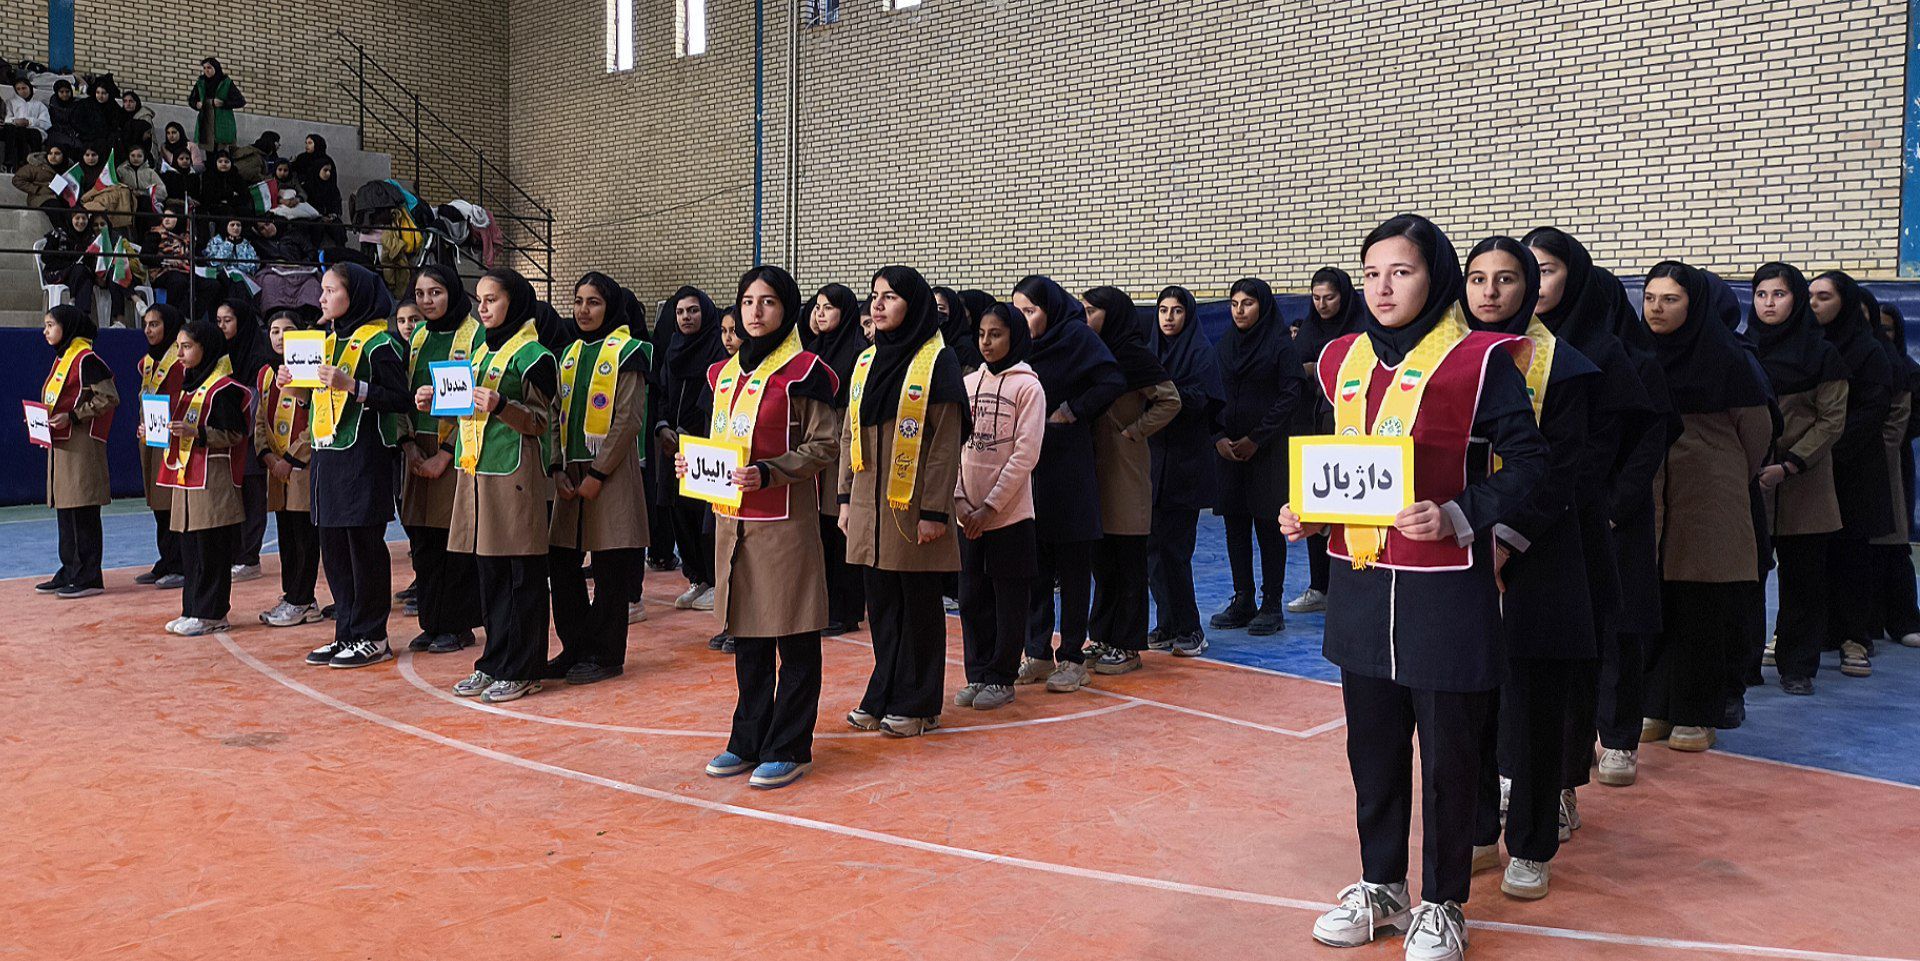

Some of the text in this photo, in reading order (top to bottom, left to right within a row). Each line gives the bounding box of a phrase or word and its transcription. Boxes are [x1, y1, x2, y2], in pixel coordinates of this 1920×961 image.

[440, 378, 467, 397] هندبال
[691, 456, 732, 487] والیبال
[1312, 462, 1393, 500] داژبال
